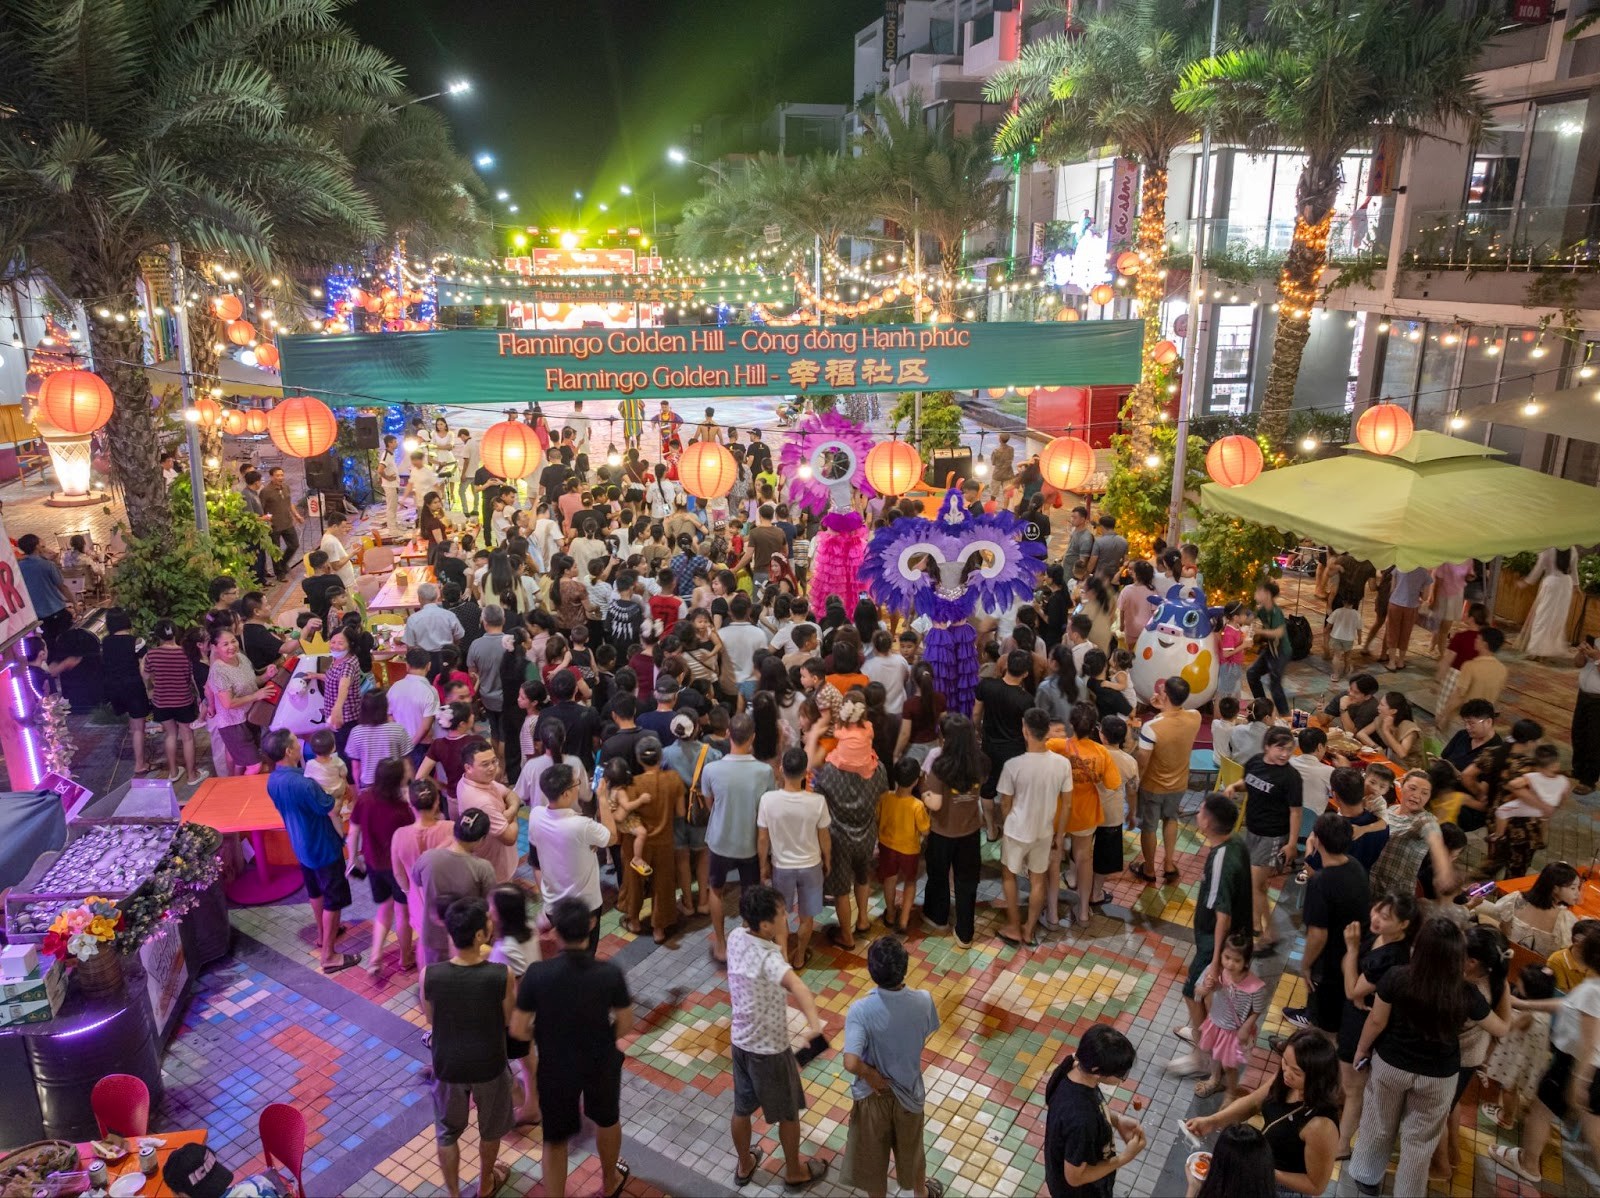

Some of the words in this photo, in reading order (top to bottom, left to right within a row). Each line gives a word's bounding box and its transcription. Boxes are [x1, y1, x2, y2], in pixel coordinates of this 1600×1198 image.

[886, 20, 896, 58] MOON
[498, 333, 604, 360] Flamingo
[607, 331, 687, 355] Golden
[691, 330, 726, 353] Hill
[741, 329, 799, 355] Cộng
[862, 327, 916, 351] Hạnh
[919, 325, 970, 352] phúc
[545, 367, 649, 394] Flamingo
[652, 366, 731, 389] Golden
[734, 364, 769, 387] Hill
[788, 358, 930, 390] 幸福社区
